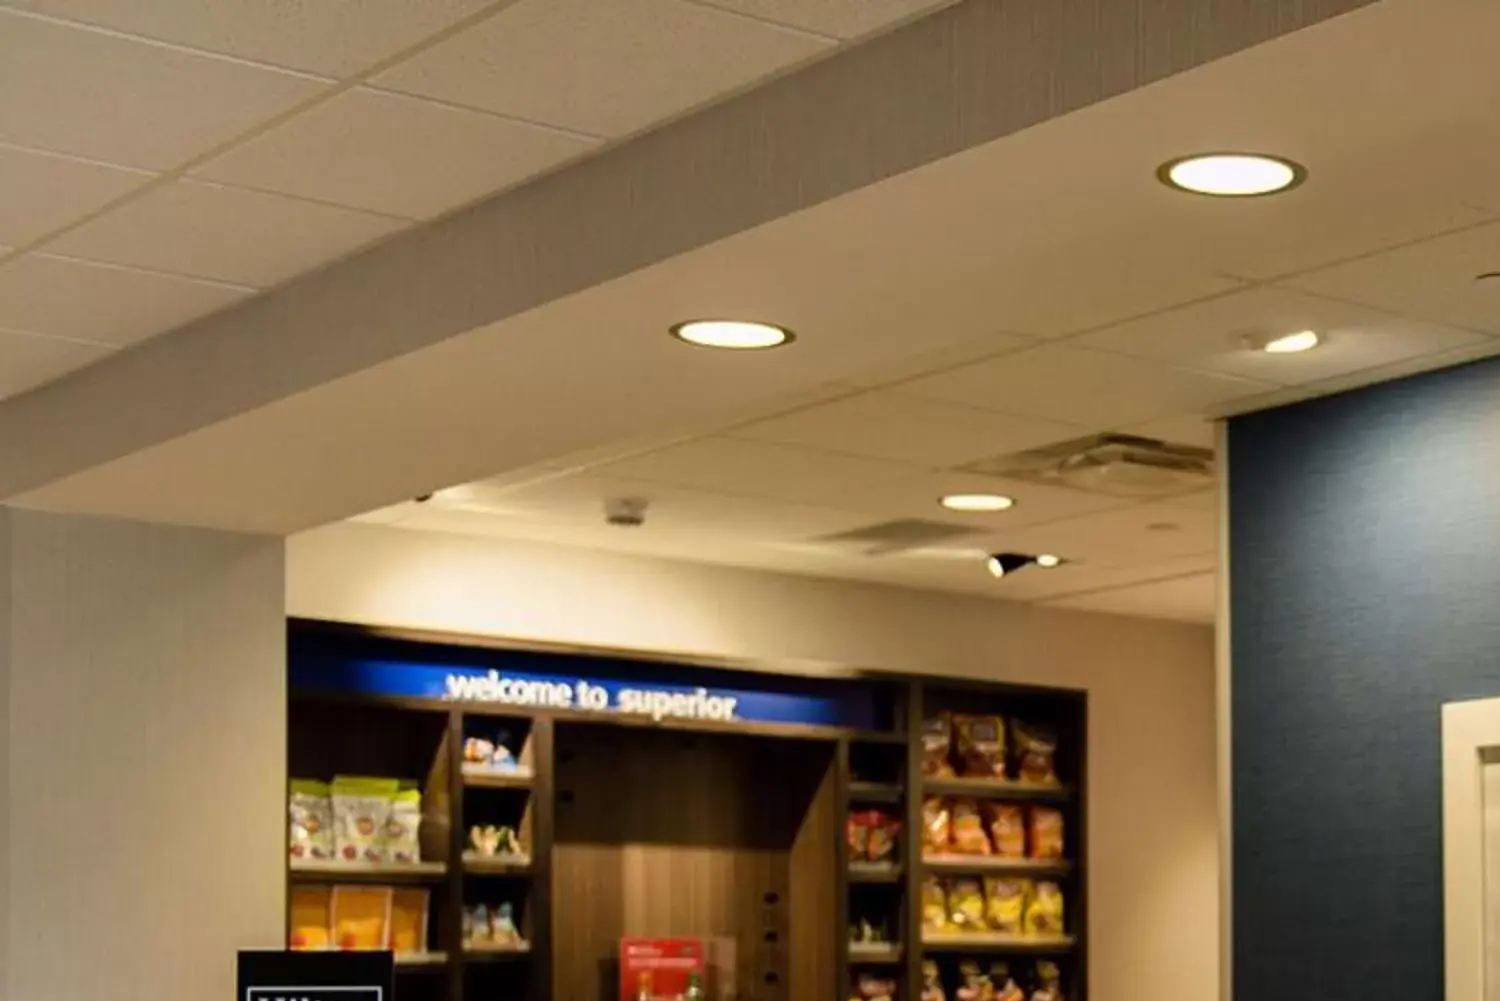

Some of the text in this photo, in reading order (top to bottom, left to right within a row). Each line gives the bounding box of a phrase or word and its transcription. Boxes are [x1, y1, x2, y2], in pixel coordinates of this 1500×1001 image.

[446, 669, 737, 721] welcome to superior
